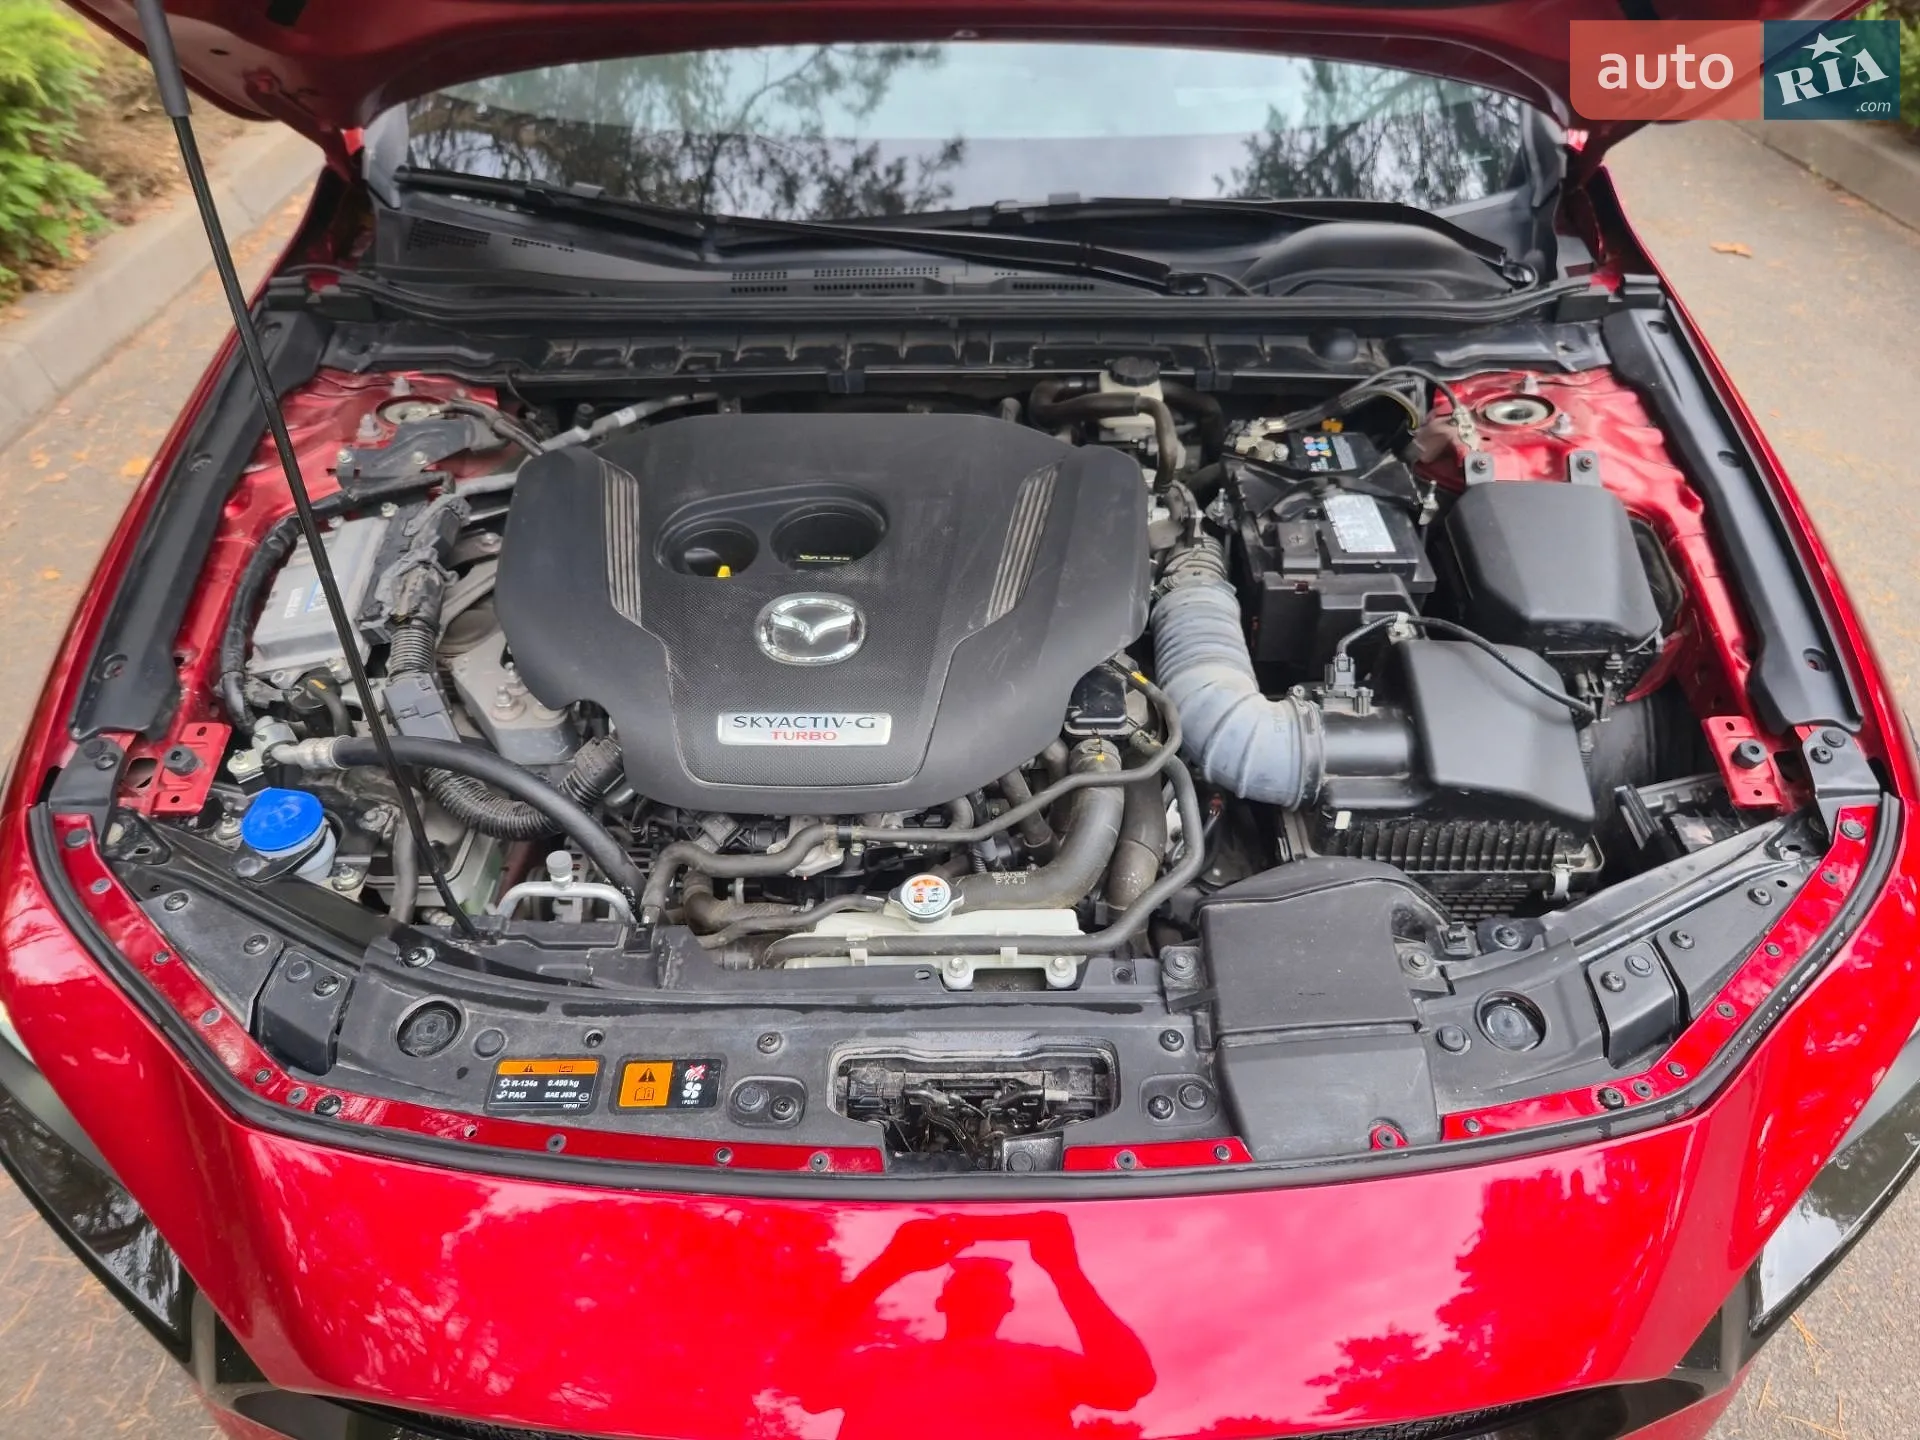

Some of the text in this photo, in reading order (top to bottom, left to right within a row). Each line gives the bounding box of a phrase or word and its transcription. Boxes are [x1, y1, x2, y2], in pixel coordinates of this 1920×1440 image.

[733, 715, 876, 729] SKYACTIV-G
[770, 731, 838, 741] TURBO
[569, 1080, 580, 1088] kg
